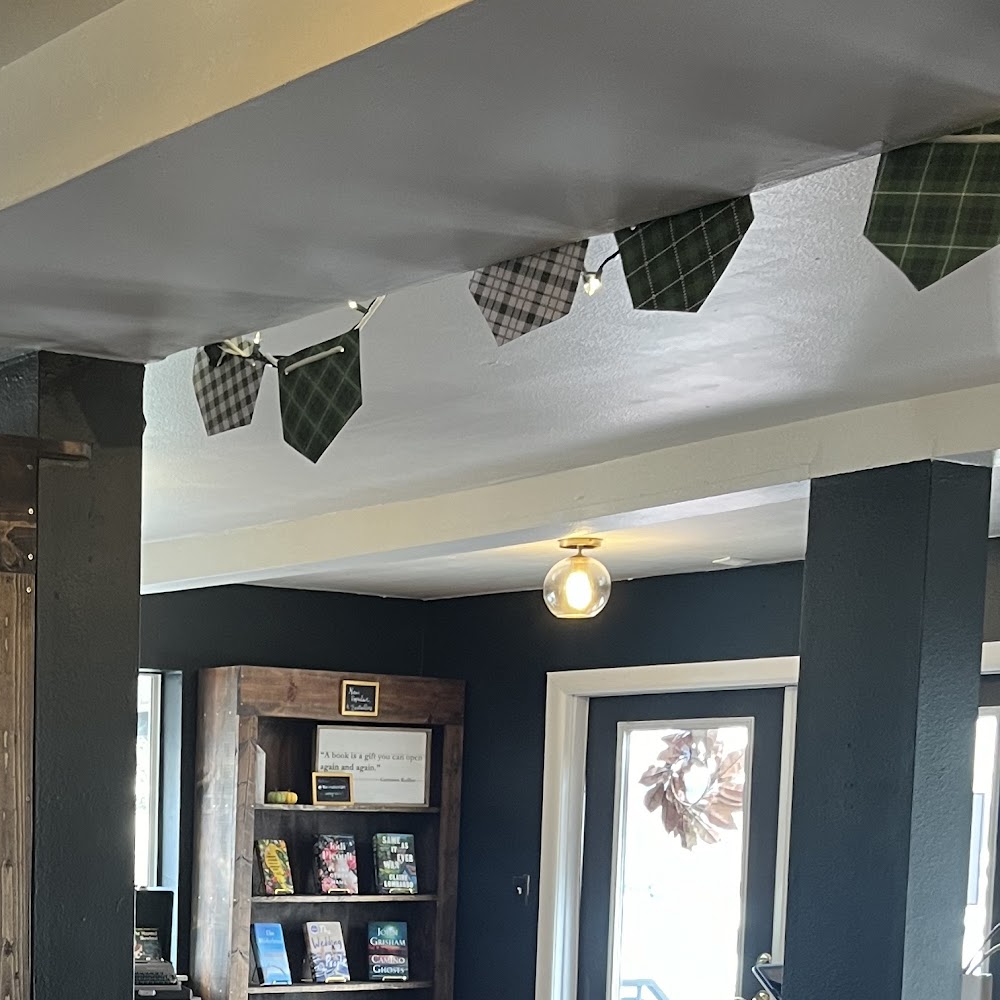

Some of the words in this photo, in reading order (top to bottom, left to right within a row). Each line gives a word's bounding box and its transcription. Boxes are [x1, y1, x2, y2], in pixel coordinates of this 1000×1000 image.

[364, 753, 376, 761] gift
[378, 754, 390, 762] you
[382, 836, 400, 844] SAME
[400, 841, 409, 849] AS
[311, 937, 342, 949] Wedding
[370, 937, 406, 946] GRISHAM
[371, 955, 405, 964] CAMINO
[372, 964, 405, 974] GHOSTS
